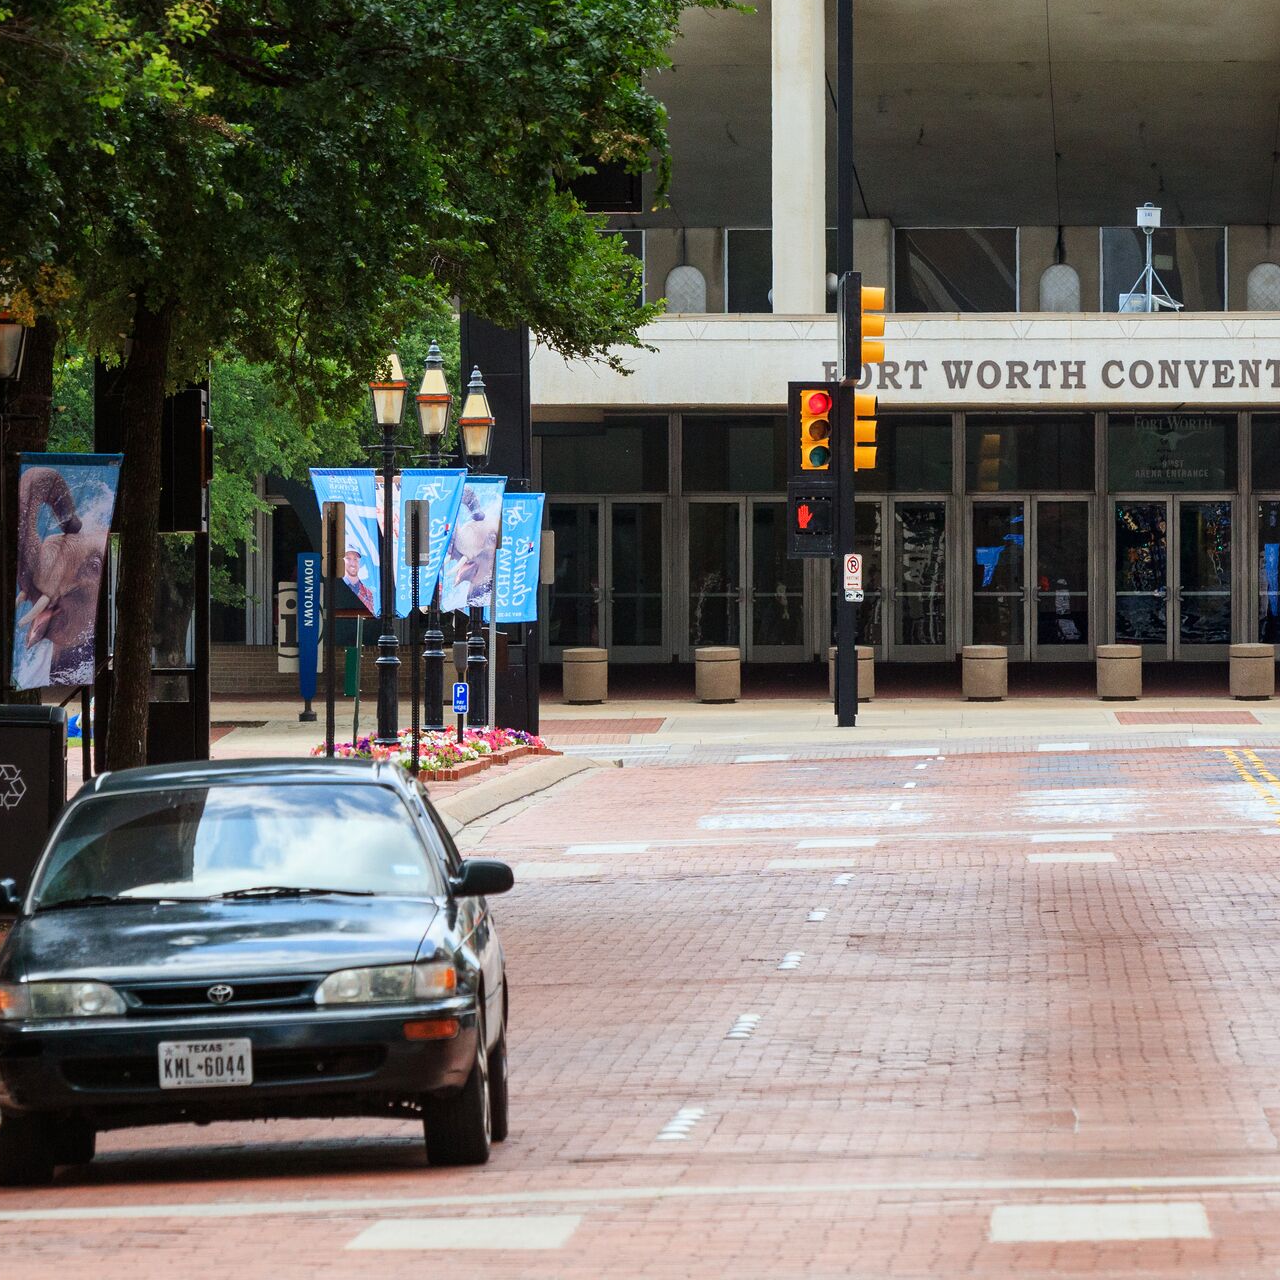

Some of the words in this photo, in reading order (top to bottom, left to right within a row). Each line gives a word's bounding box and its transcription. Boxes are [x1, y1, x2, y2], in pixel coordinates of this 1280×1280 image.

[941, 360, 1087, 389] WORTH
[304, 559, 314, 627] DOWNTOWN
[187, 1043, 222, 1053] TEXAS
